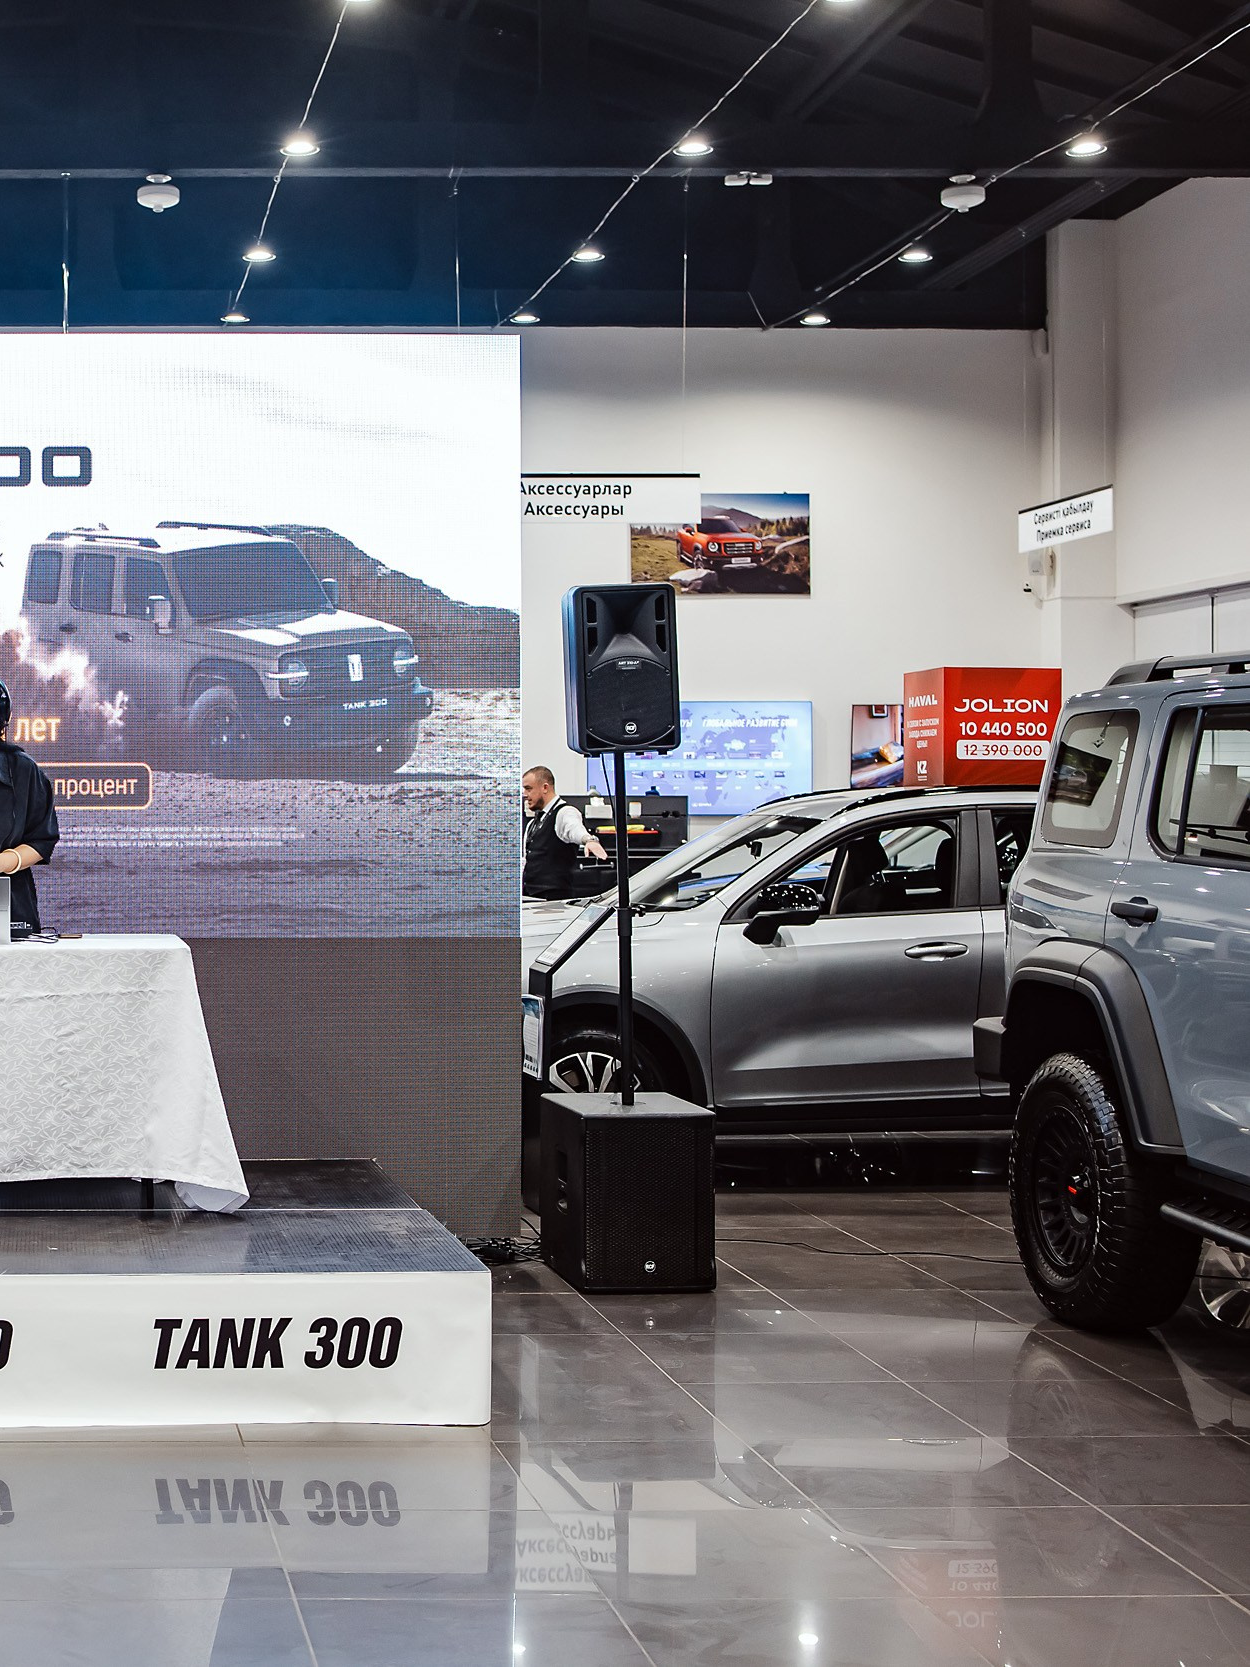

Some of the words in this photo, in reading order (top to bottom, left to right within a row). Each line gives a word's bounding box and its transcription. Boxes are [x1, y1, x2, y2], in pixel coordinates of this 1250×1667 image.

[524, 501, 624, 519] Аксессуары
[1036, 526, 1064, 544] Приемка
[1064, 519, 1091, 536] сервиса
[908, 694, 938, 708] HAVAL
[953, 698, 1049, 713] JOLION
[13, 717, 61, 742] лет
[959, 721, 977, 736] 10
[981, 722, 1012, 736] 440
[1016, 722, 1047, 736] 500
[963, 744, 978, 756] 12
[982, 744, 1009, 756] 390
[1013, 744, 1043, 756] 000
[916, 760, 928, 775] KZ
[54, 778, 138, 800] процент
[153, 1317, 293, 1370] TANK
[303, 1316, 403, 1369] 300
